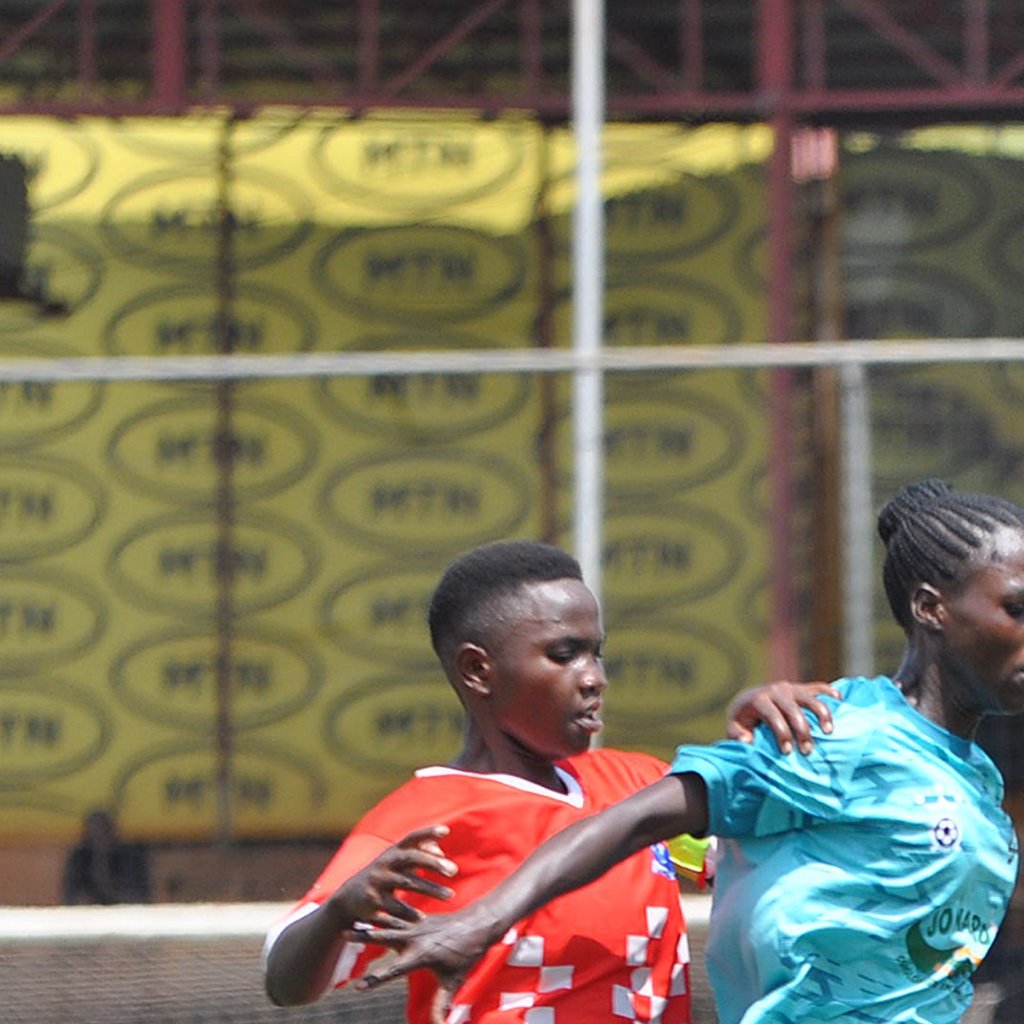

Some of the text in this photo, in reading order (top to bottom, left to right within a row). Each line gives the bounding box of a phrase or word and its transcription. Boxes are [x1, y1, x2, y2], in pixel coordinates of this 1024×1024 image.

[365, 140, 472, 169] MTN
[366, 251, 475, 281] MTN
[372, 483, 480, 514] MTN
[164, 661, 270, 688] MN
[166, 775, 273, 803] MN
